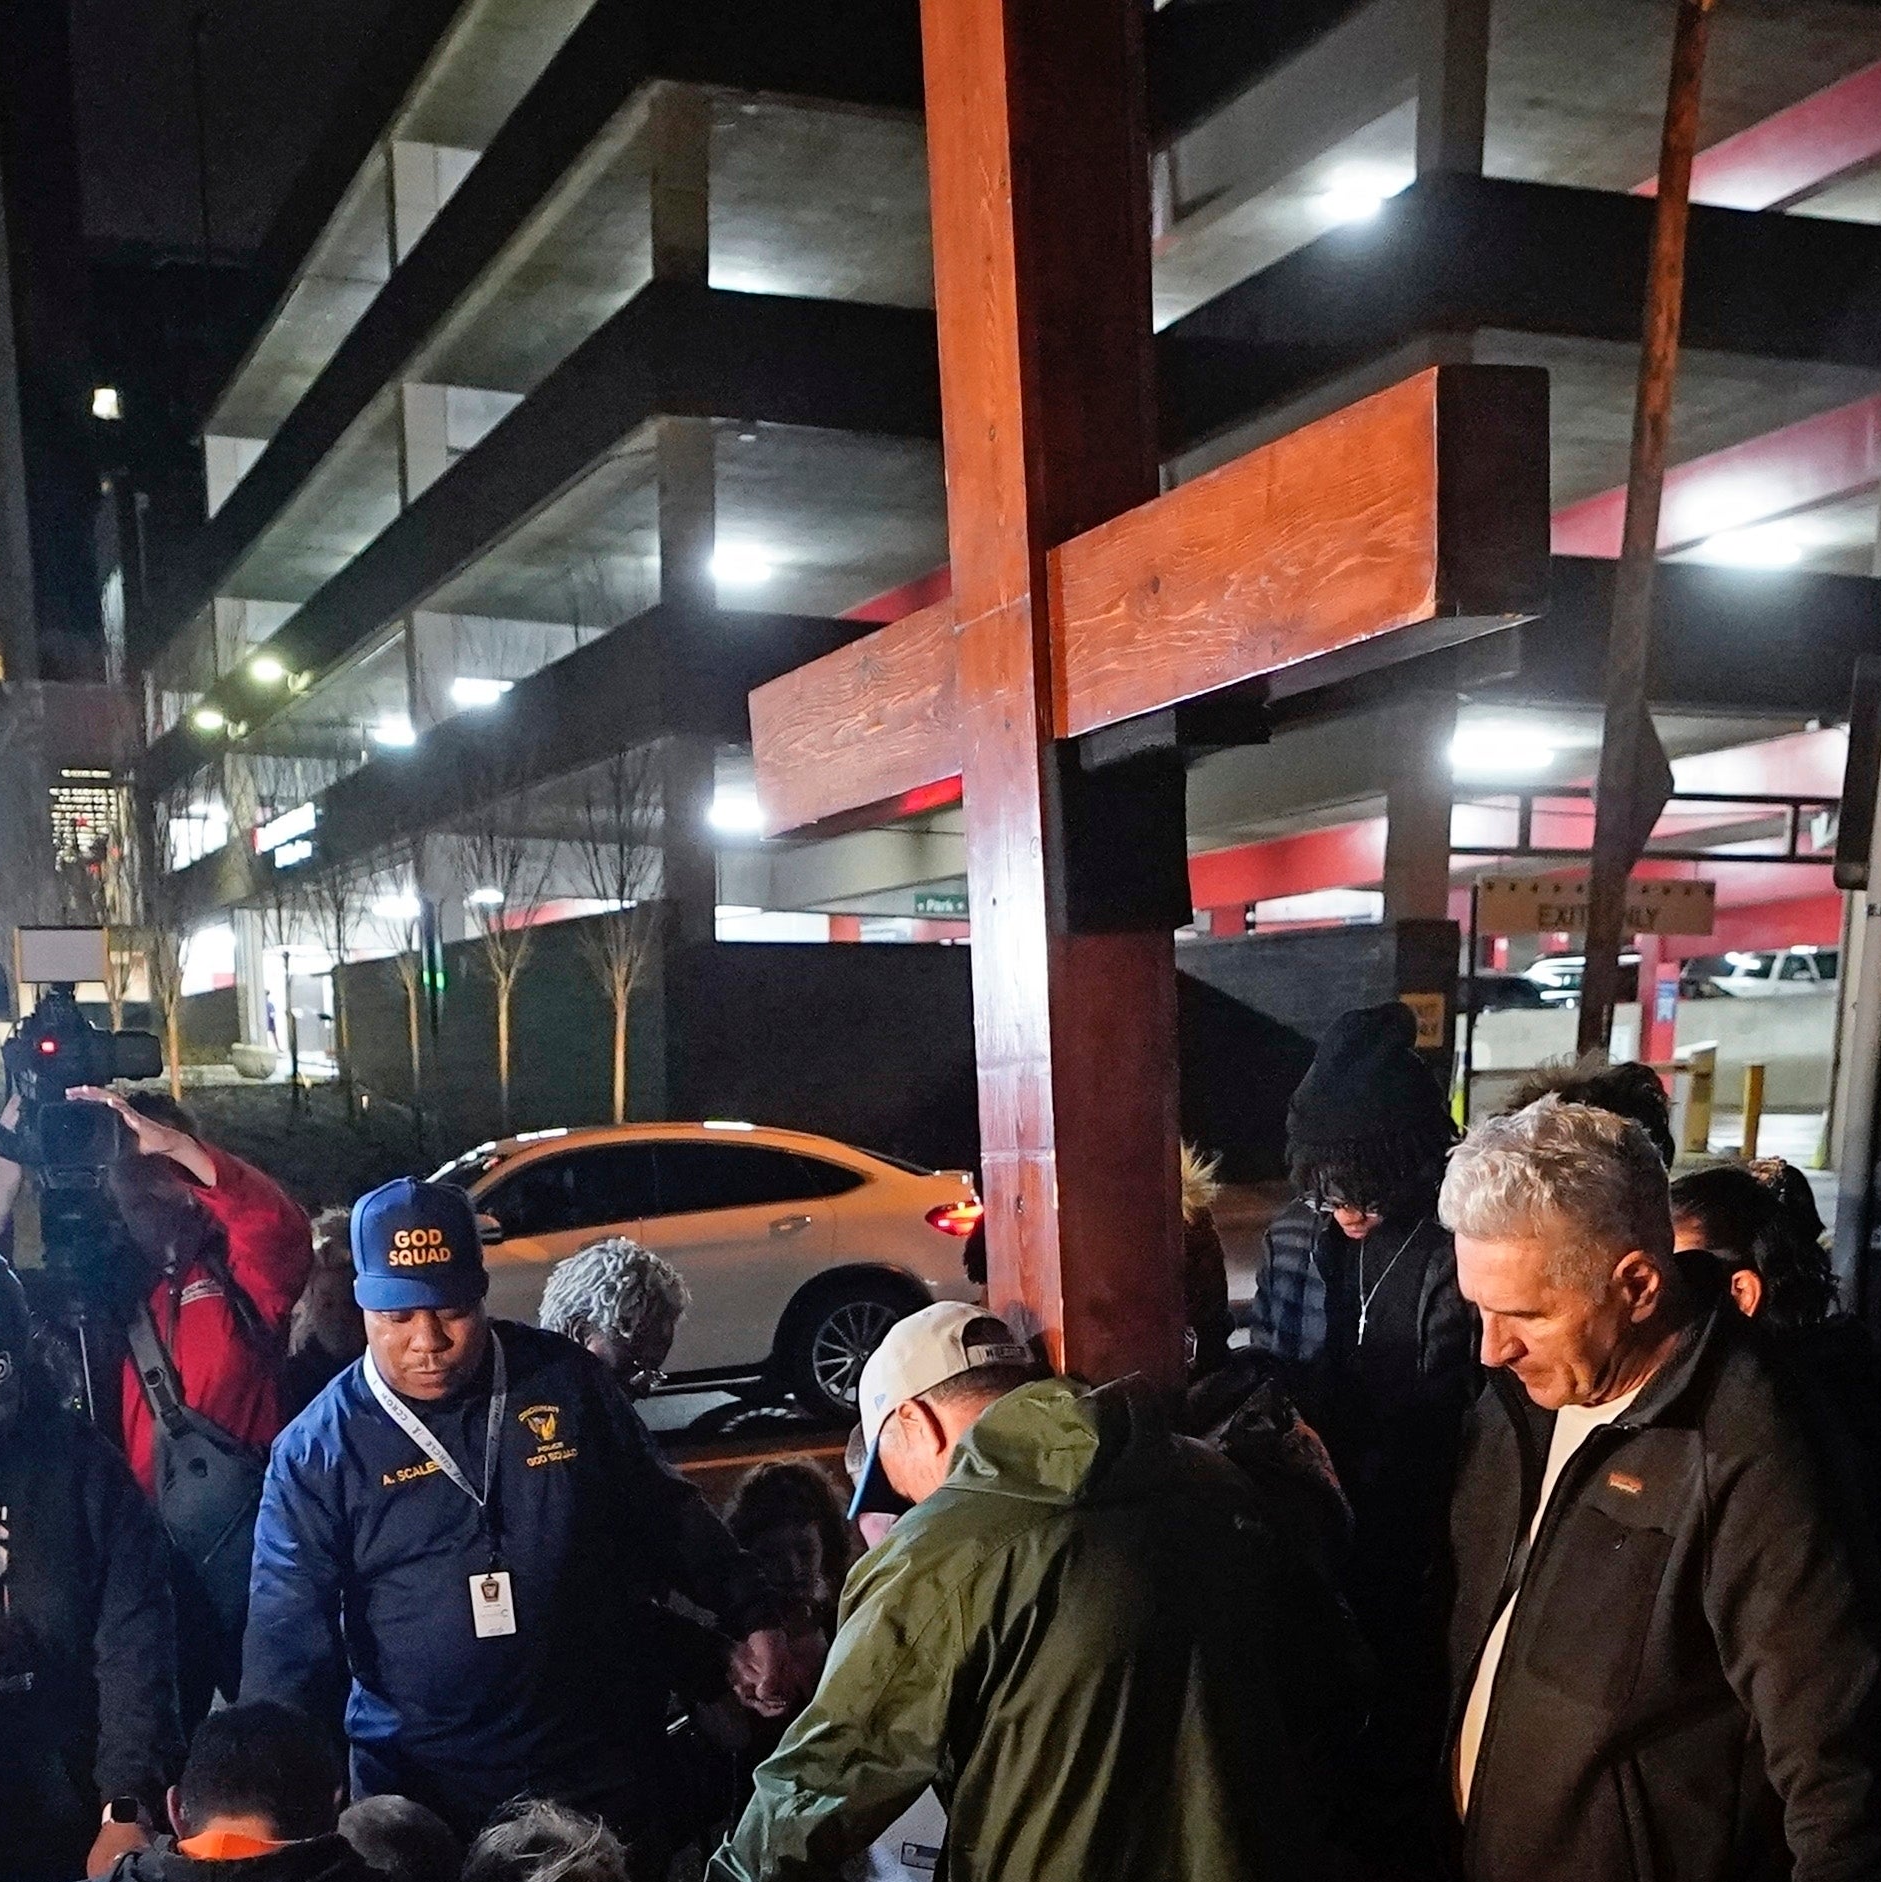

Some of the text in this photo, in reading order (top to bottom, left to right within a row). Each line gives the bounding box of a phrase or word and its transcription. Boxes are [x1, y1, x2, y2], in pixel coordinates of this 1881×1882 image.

[1626, 906, 1661, 932] NLY
[394, 1228, 442, 1248] GOD
[388, 1247, 452, 1266] SQUAD
